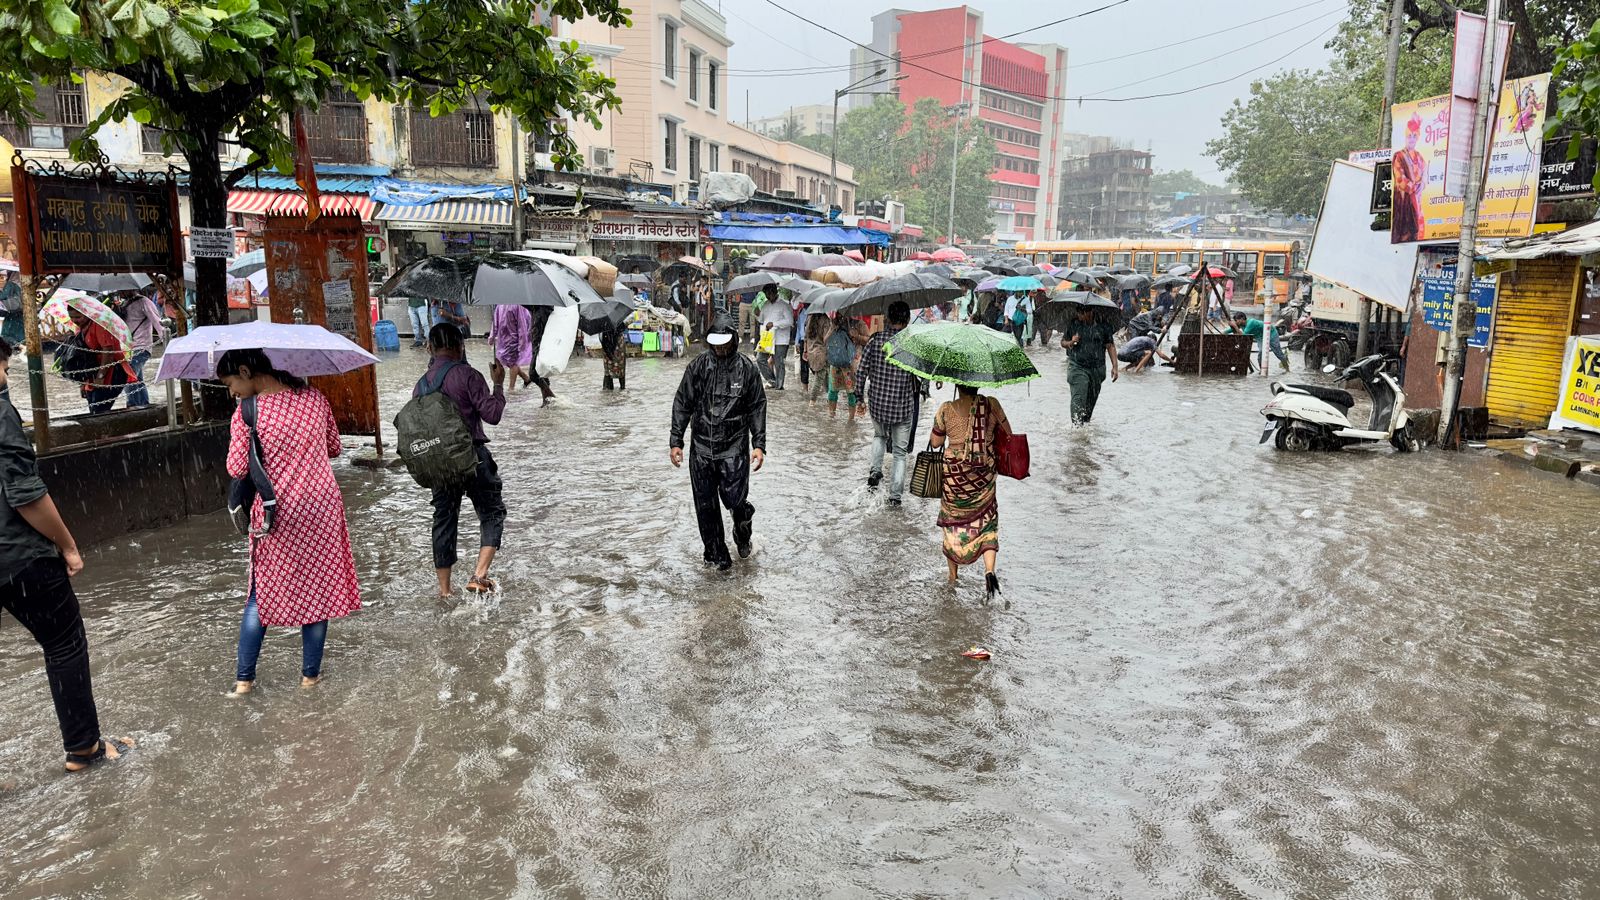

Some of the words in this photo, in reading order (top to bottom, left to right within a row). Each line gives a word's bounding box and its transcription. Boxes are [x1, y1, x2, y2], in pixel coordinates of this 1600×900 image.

[1374, 150, 1392, 158] POLICE
[134, 194, 160, 224] चौक
[544, 223, 573, 232] FLORIST
[592, 222, 636, 236] आराधना
[637, 220, 674, 236] नोवेल्टी
[676, 220, 696, 238] स्टोर
[42, 230, 94, 252] MEHMOOD
[96, 232, 136, 253] DURRANI
[140, 234, 168, 254] CHOWK
